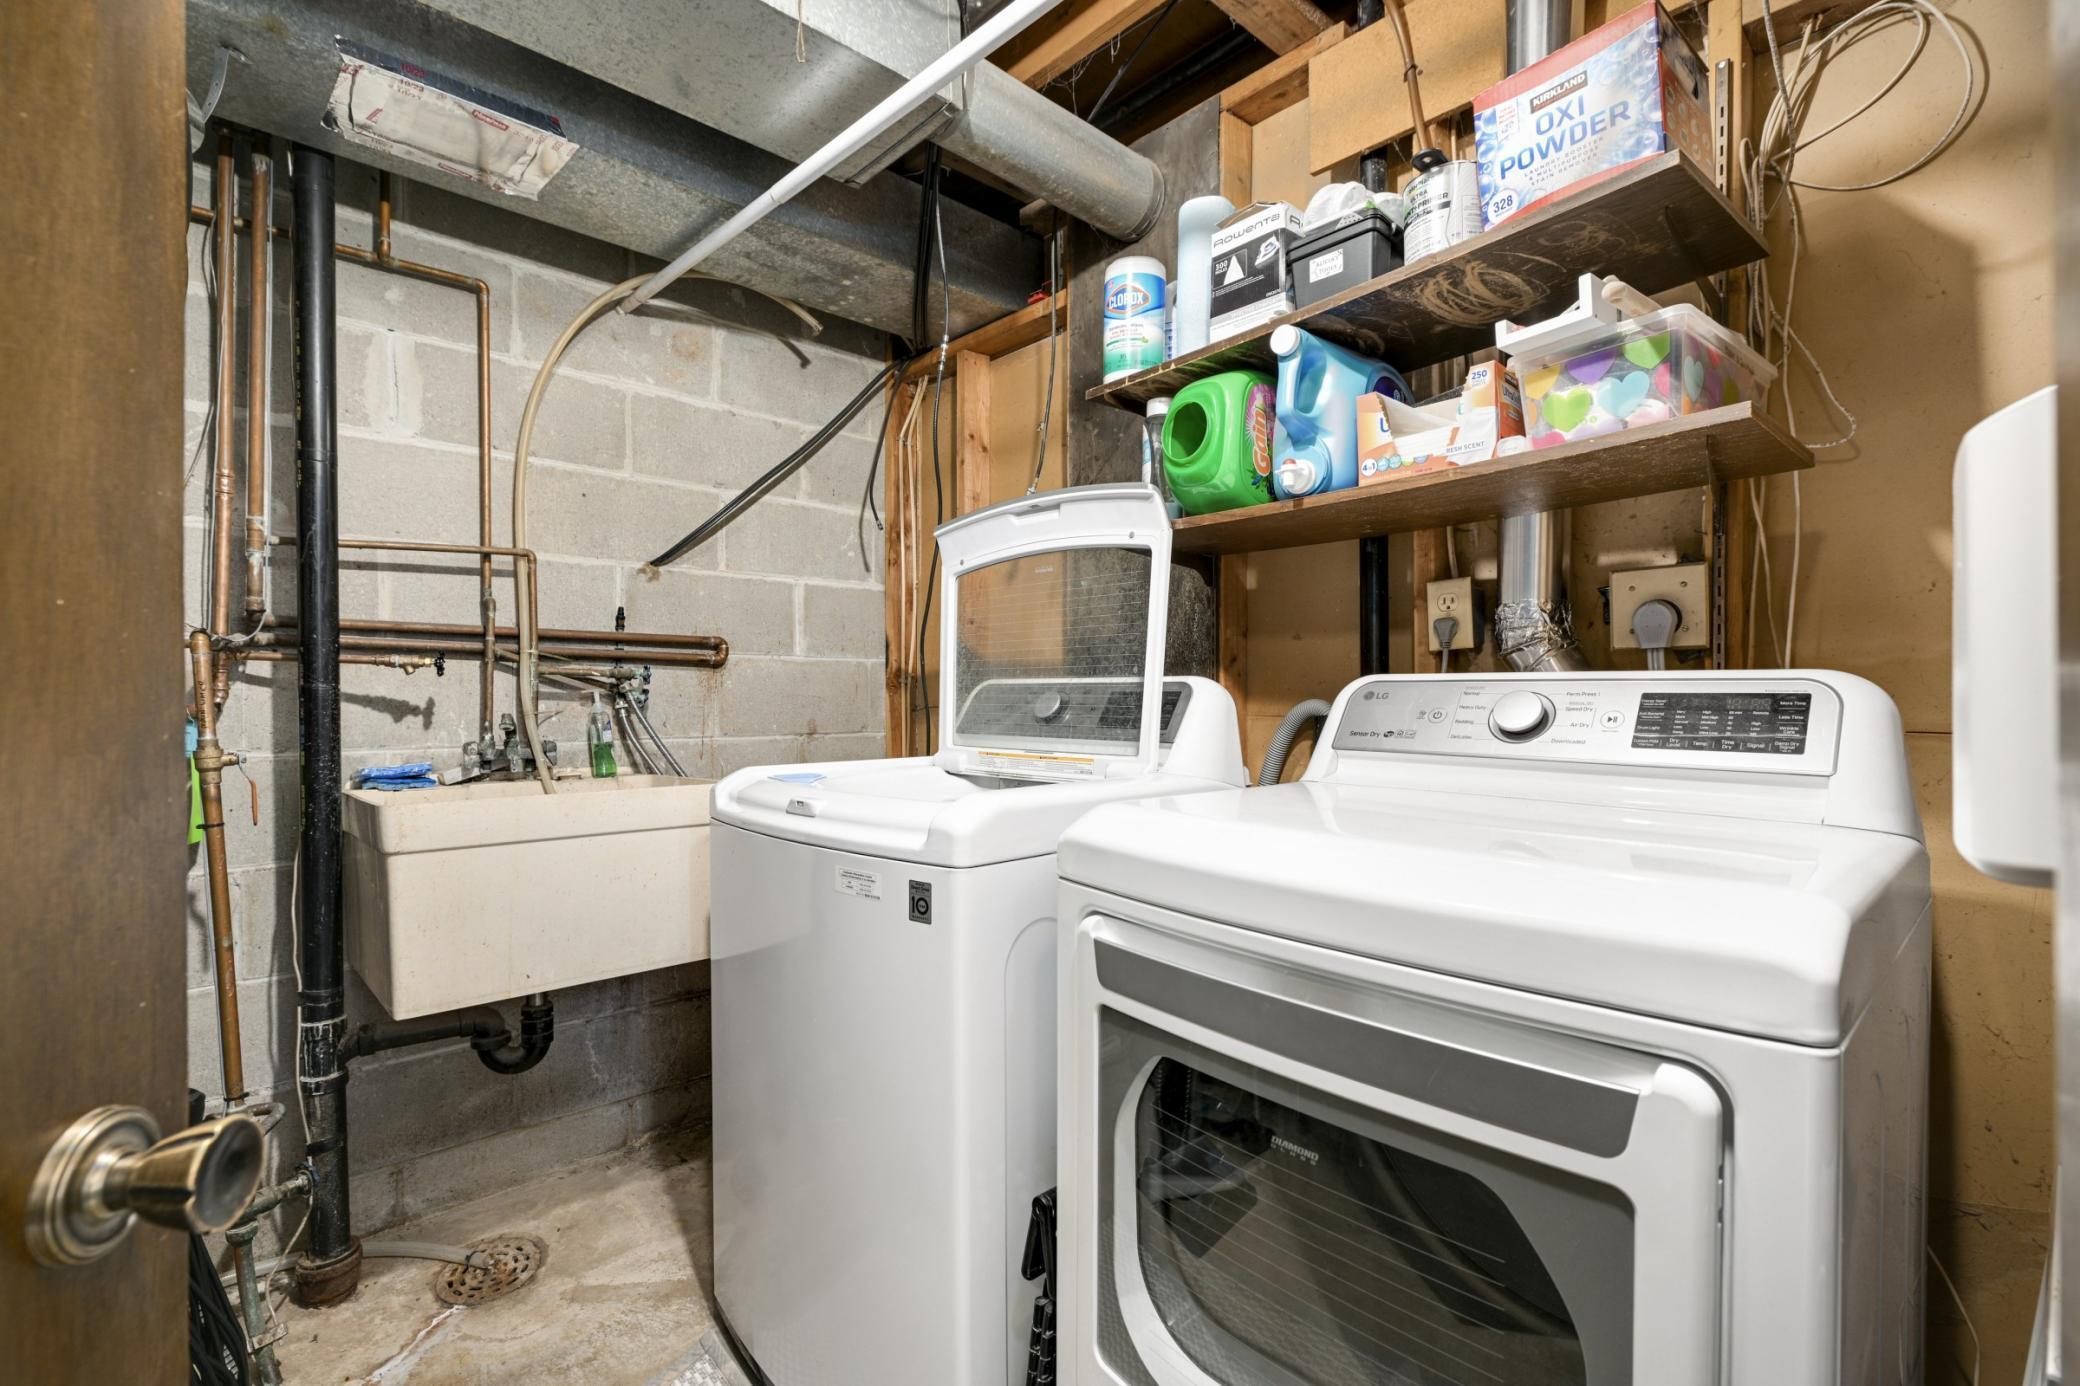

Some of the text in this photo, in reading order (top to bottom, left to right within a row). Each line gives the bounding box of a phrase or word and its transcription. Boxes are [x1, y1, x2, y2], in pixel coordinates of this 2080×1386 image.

[1532, 73, 1586, 106] KIRKLAND
[1536, 94, 1585, 136] OXI
[1500, 100, 1632, 180] POWDER
[1493, 195, 1514, 214] 328
[1108, 292, 1144, 310] CLOROX
[1472, 370, 1488, 380] 250
[1252, 407, 1272, 476] Gain
[1446, 441, 1485, 454] RESH SCENT
[912, 896, 929, 915] 10
[1271, 1135, 1319, 1160] DIAMOND
